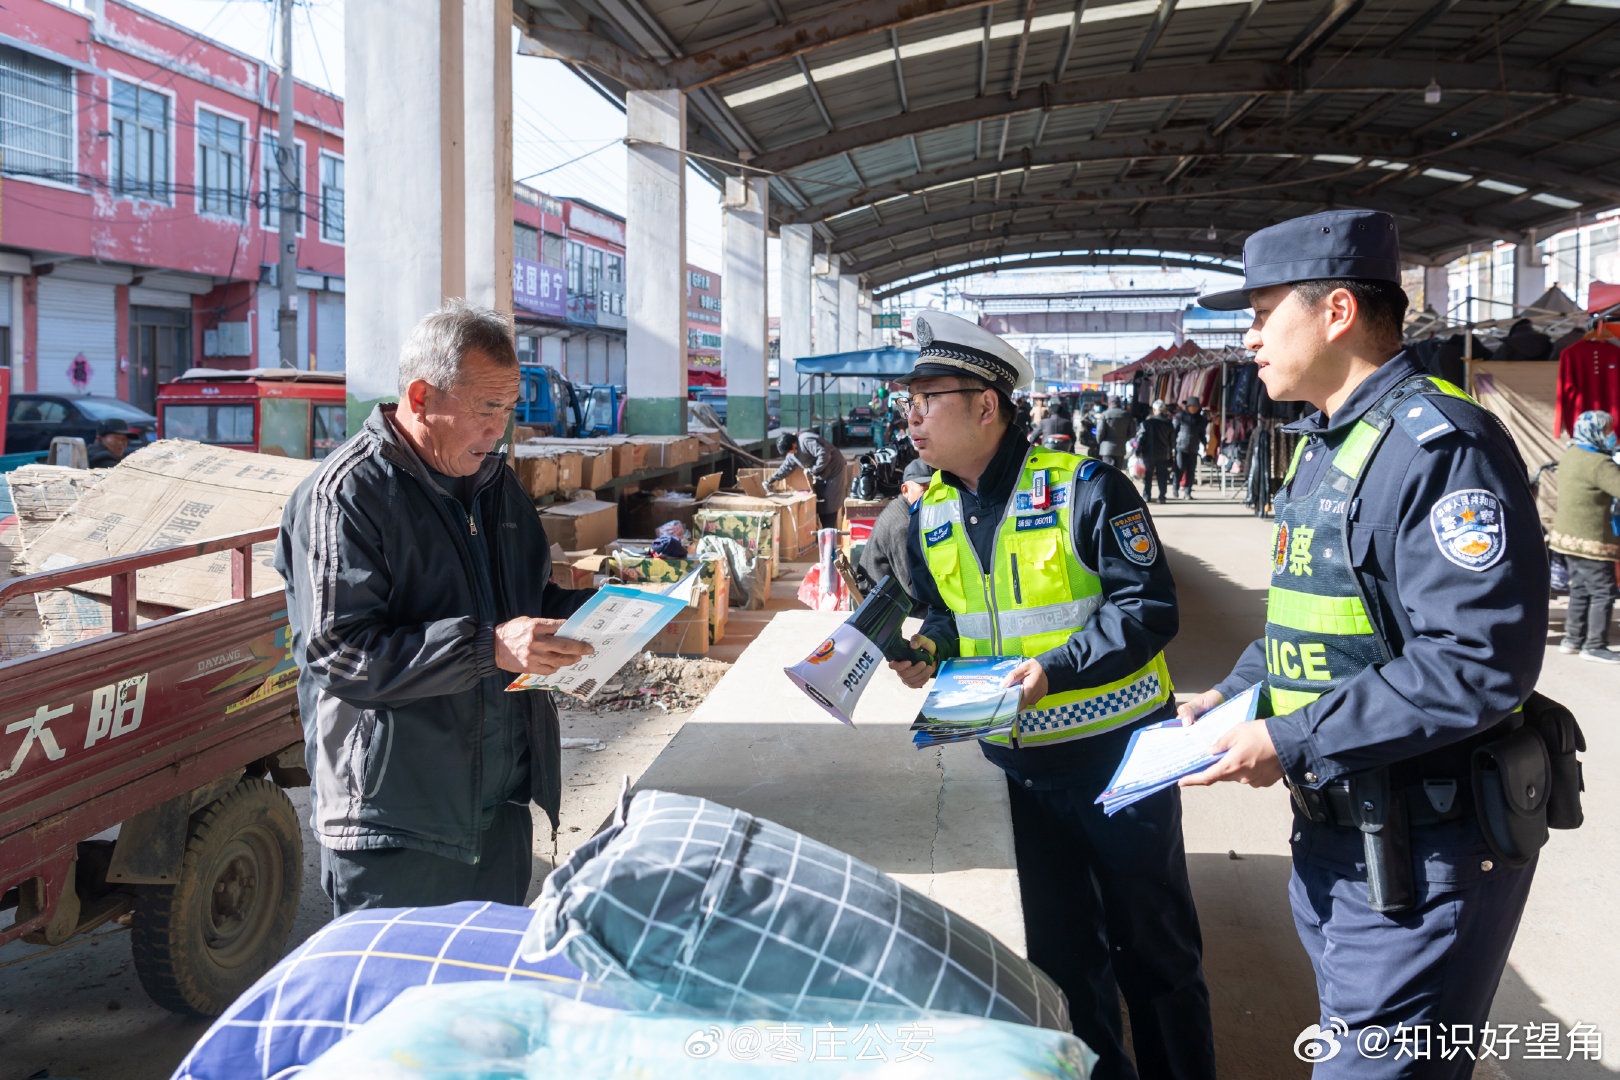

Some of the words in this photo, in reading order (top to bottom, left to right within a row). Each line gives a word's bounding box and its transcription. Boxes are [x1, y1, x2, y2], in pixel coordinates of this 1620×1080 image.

[1436, 494, 1497, 518] 中华人民共和国
[197, 649, 241, 671] DAYANG
[843, 651, 874, 692] POLICE
[0, 672, 149, 780] 大阳
